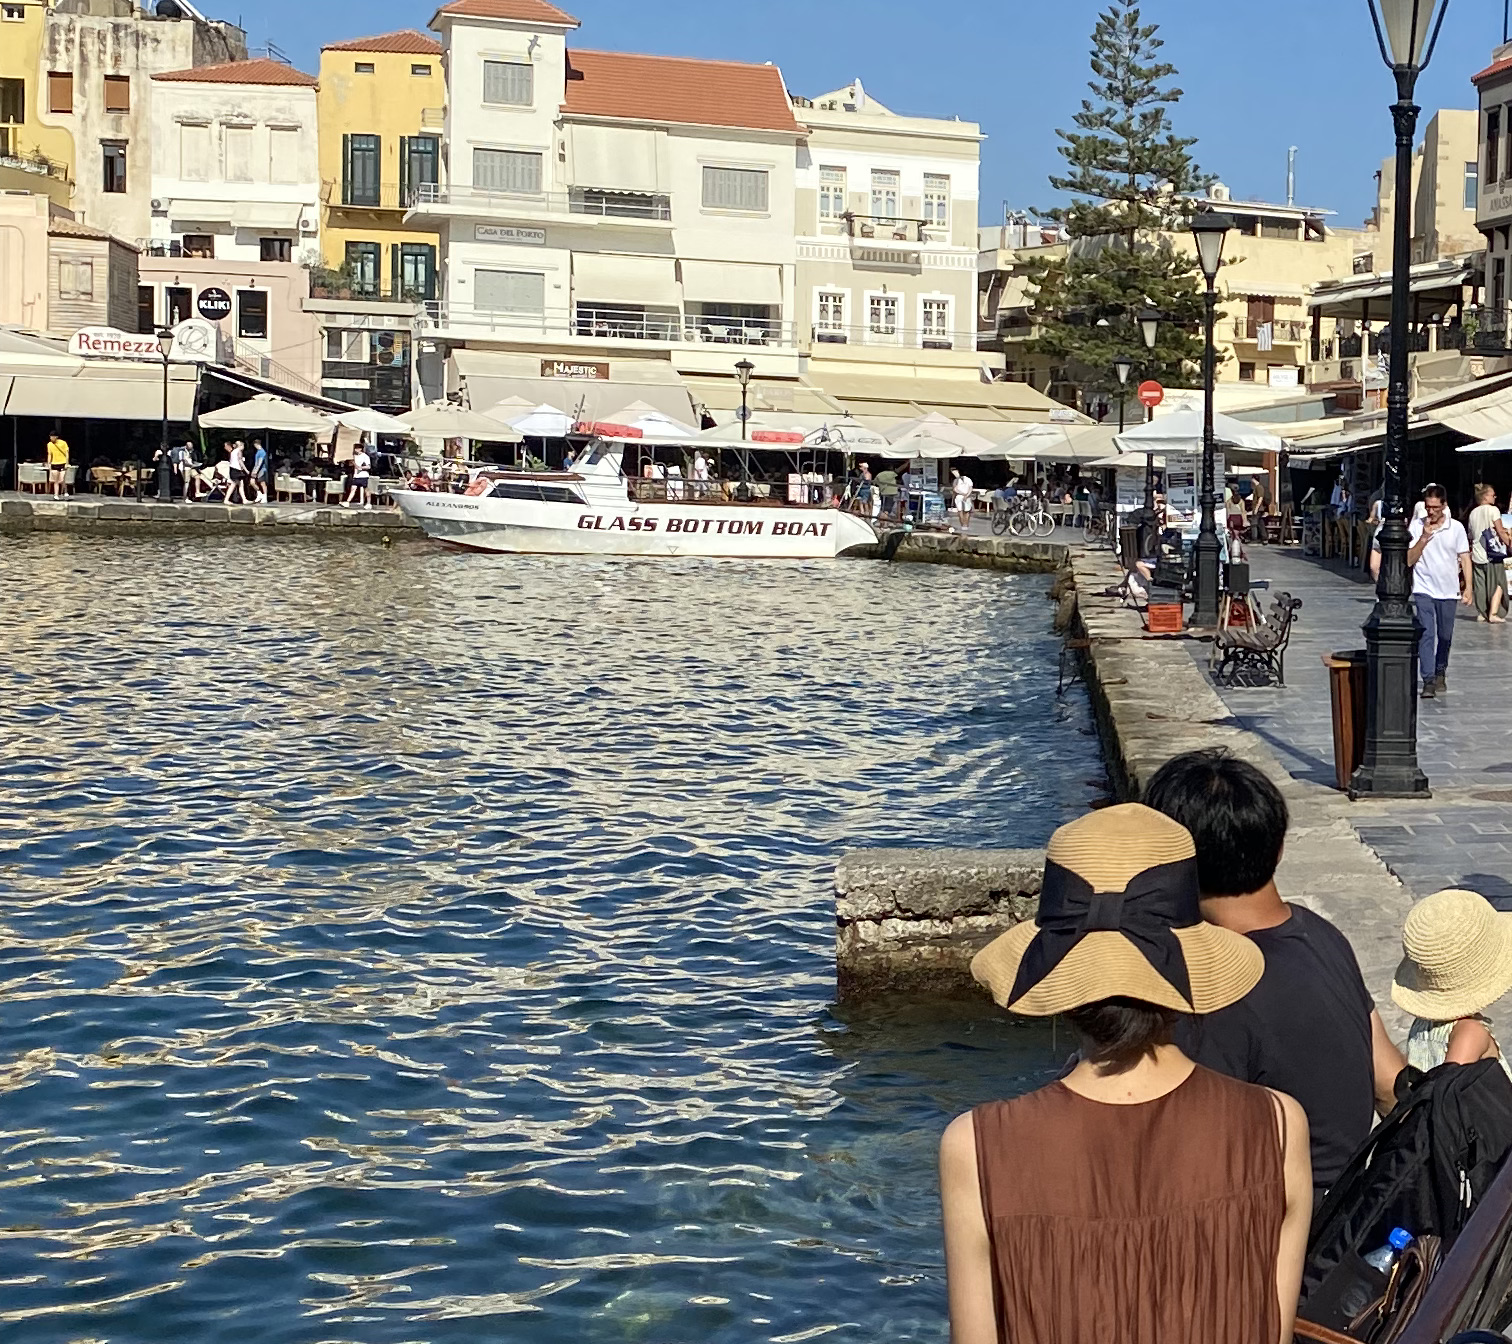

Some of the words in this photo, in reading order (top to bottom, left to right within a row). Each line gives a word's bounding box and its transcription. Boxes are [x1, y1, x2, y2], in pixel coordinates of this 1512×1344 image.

[476, 226, 498, 236] CASA
[499, 229, 515, 237] DEL
[516, 229, 544, 239] PORTO
[199, 299, 231, 311] KLIKI
[553, 361, 597, 375] MAJESTIC
[577, 514, 659, 532] GLASS
[665, 518, 765, 535] BOTTOM
[771, 522, 833, 537] BOAT
